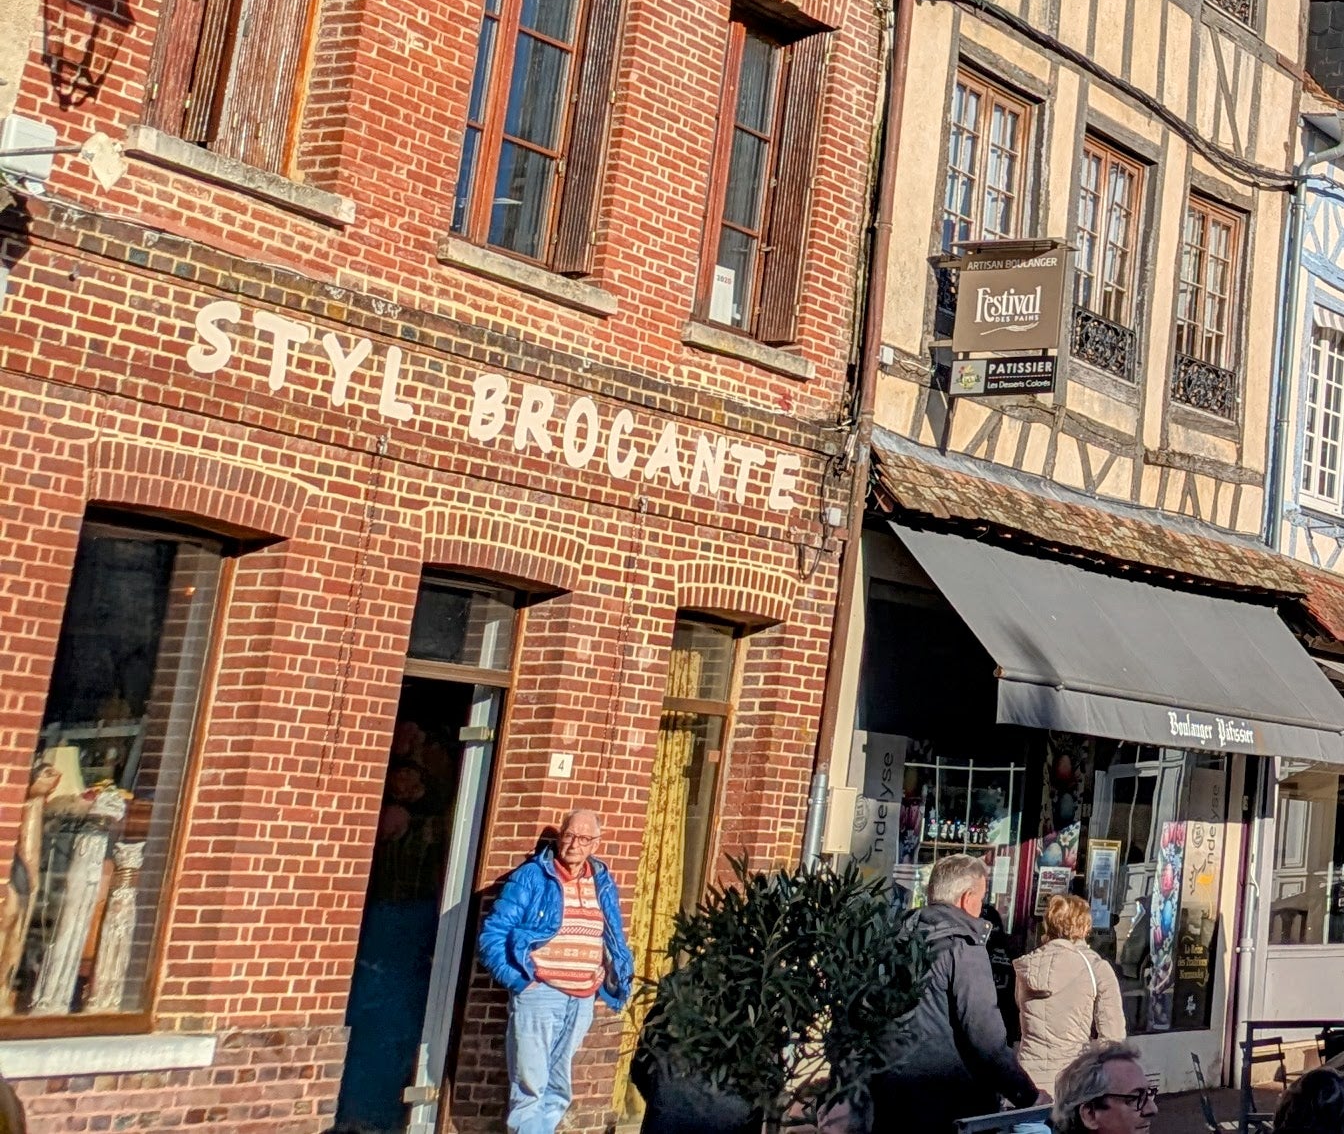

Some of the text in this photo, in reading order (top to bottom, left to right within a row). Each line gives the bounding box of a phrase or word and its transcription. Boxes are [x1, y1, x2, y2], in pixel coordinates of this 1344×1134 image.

[967, 257, 1058, 271] ARTISAN BOULANGER
[974, 285, 1042, 323] Festival
[995, 314, 1039, 323] DES PAINS
[988, 361, 1053, 375] PATISSIER
[987, 381, 998, 389] Les
[999, 380, 1025, 389] Desserts
[186, 300, 801, 511] STYL BROCANTE
[1167, 711, 1213, 745] Boulanger
[558, 759, 565, 772] 4
